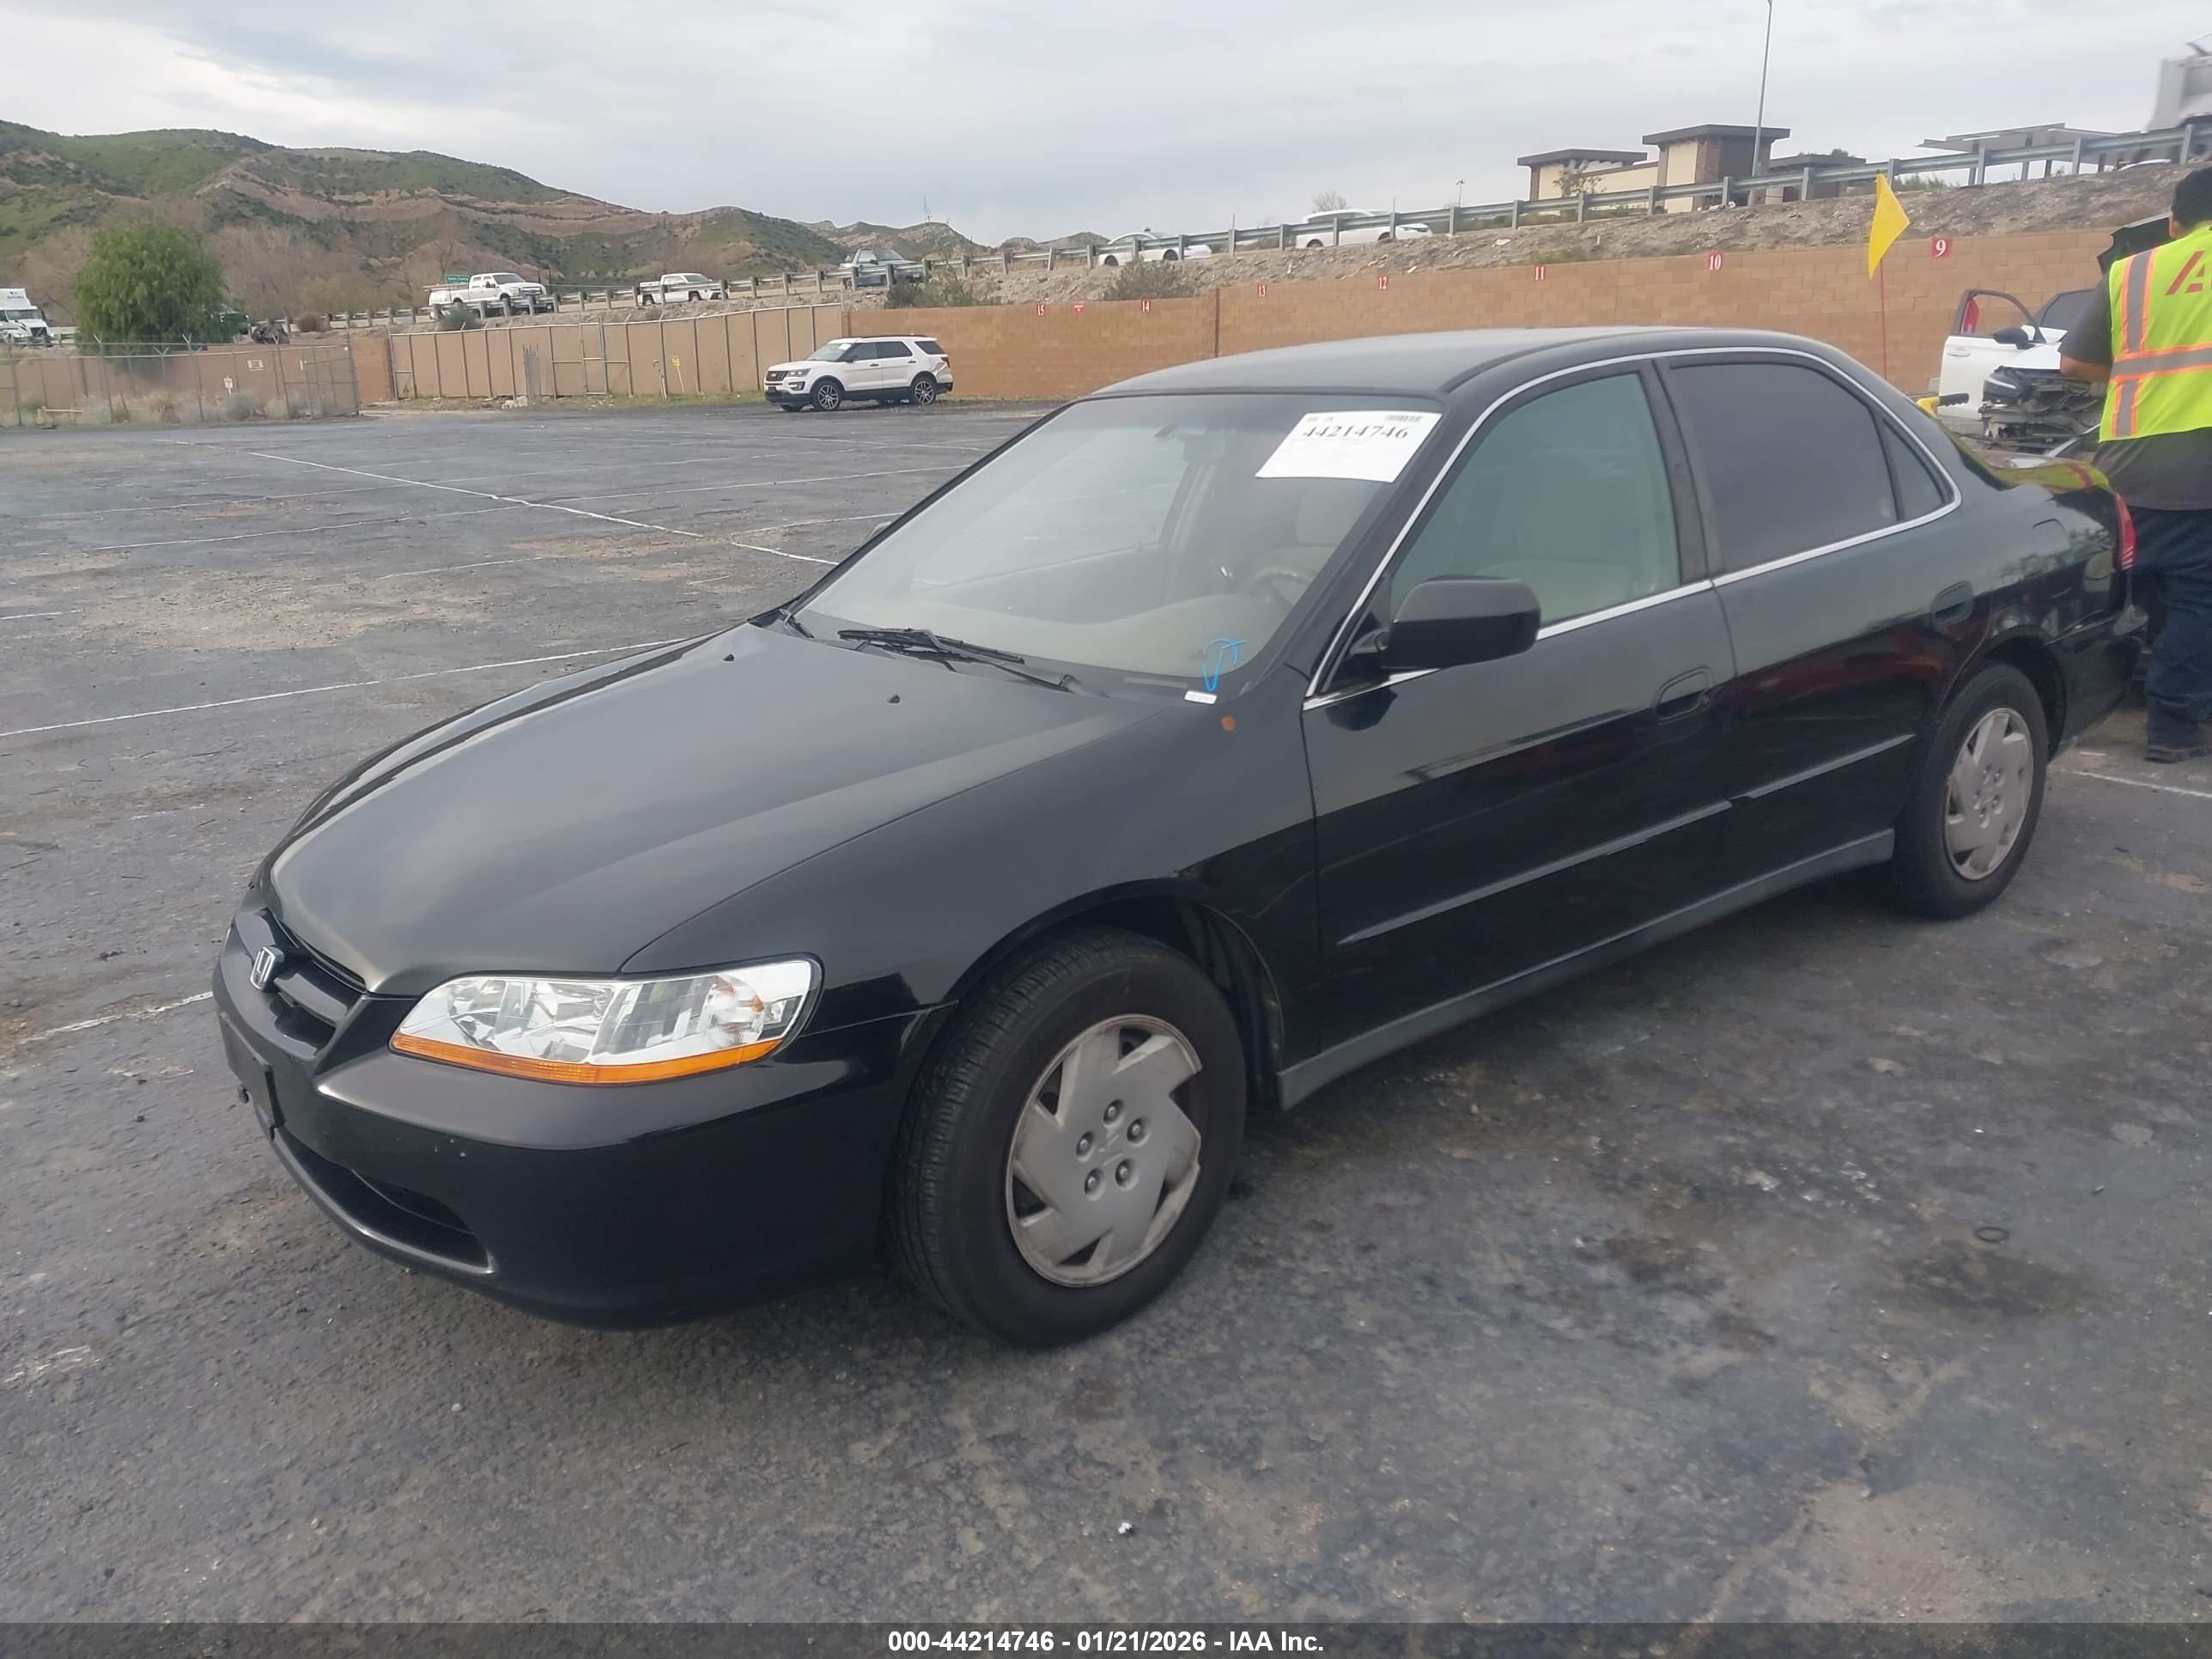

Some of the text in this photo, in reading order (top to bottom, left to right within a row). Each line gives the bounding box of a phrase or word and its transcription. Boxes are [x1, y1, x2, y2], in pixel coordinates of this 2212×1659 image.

[1935, 239, 1947, 258] 9
[1708, 254, 1722, 270] 10
[1534, 265, 1544, 281] 11
[2166, 250, 2212, 295] A
[1378, 275, 1388, 289] 12
[1258, 284, 1266, 298] 13
[1037, 305, 1045, 316] 15
[1141, 300, 1150, 313] 14
[1303, 425, 1409, 439] 44214746
